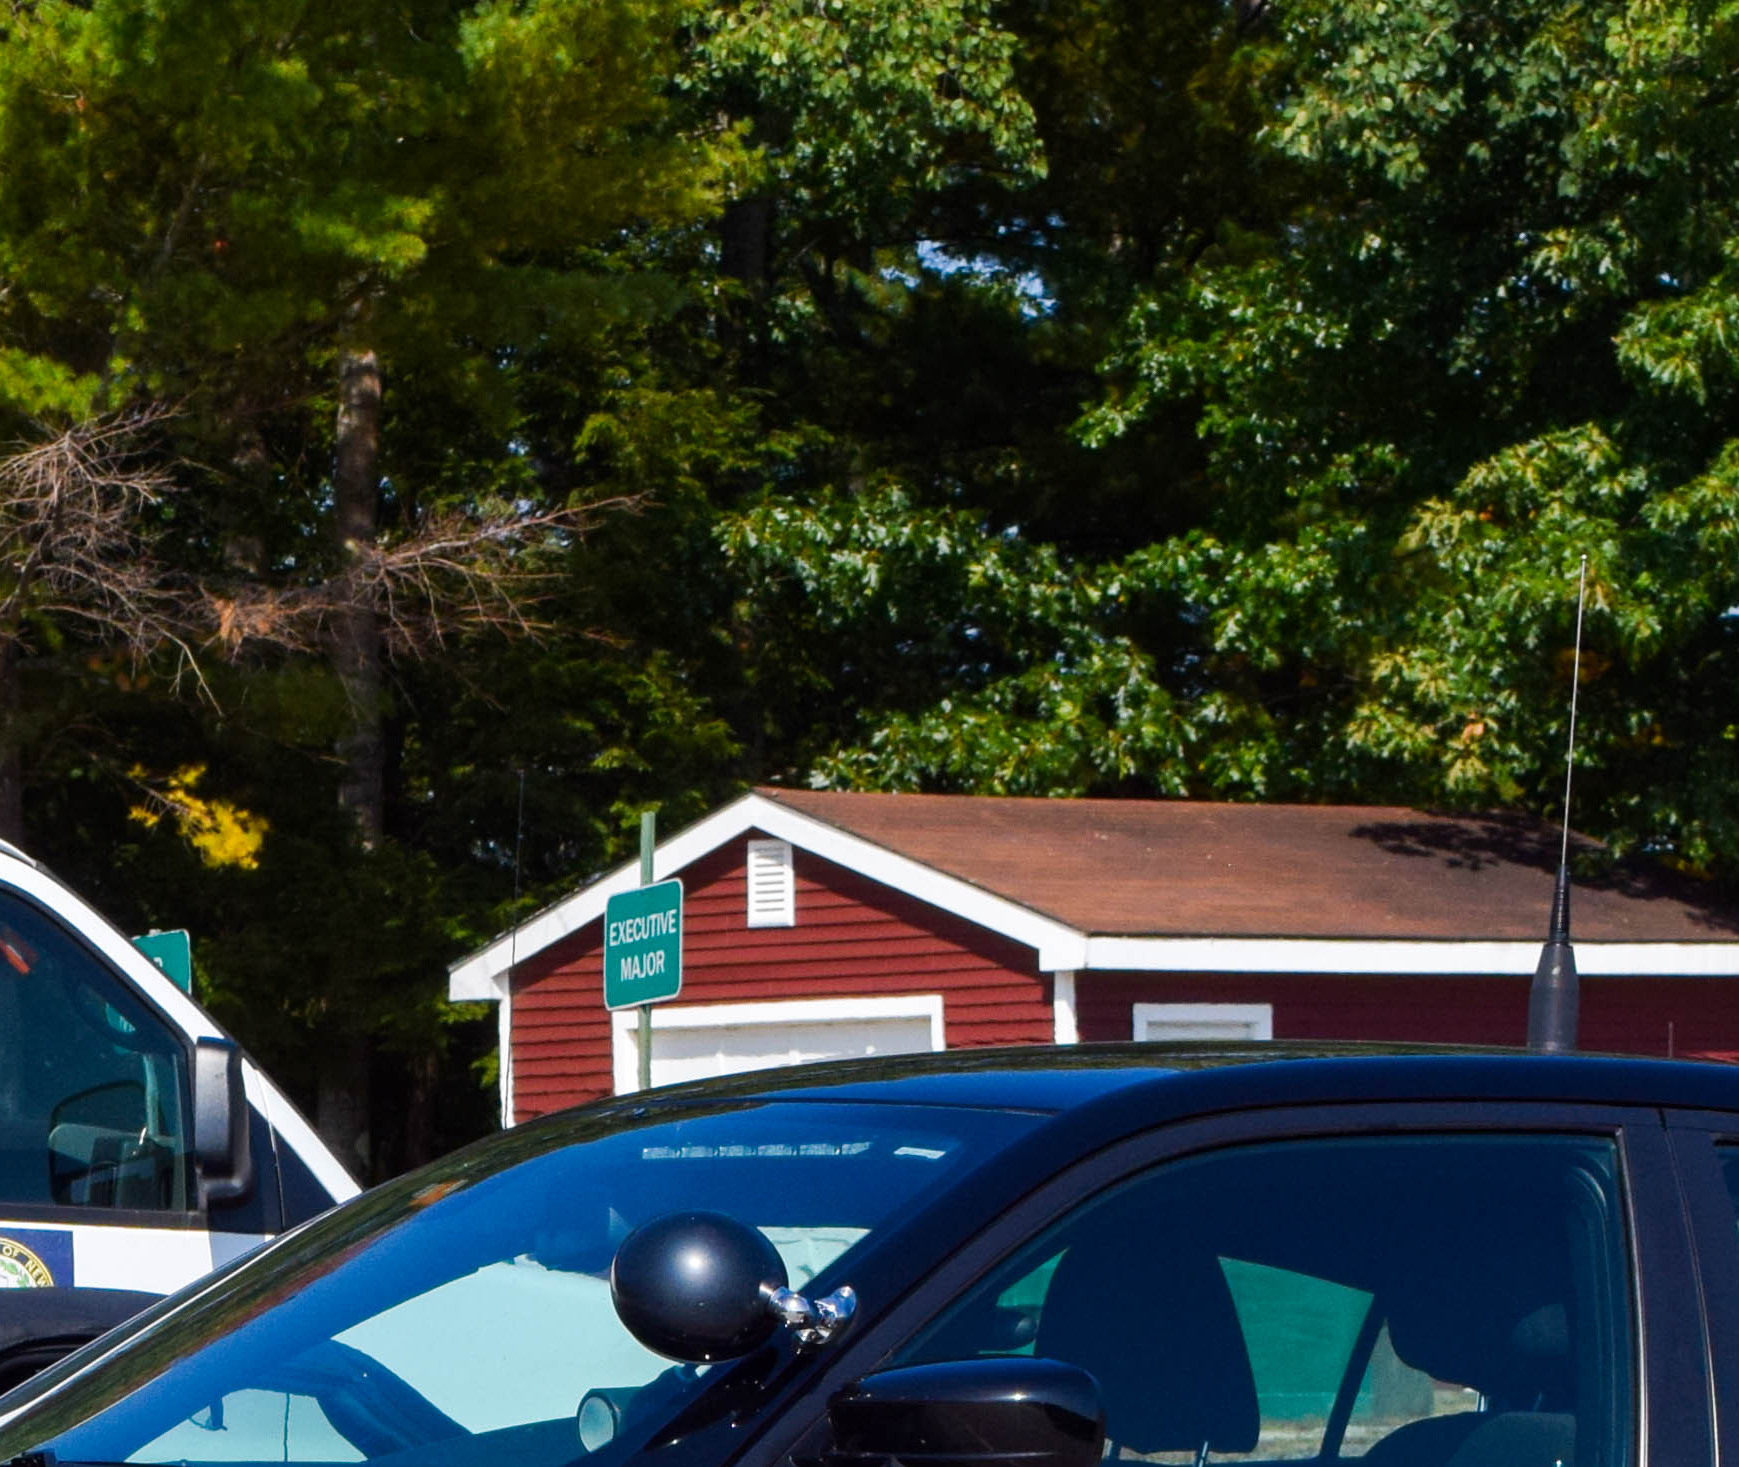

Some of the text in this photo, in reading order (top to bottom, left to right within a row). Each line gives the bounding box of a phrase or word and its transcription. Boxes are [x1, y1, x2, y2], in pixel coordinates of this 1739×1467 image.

[608, 908, 678, 947] EXECUTIVE
[620, 949, 666, 982] MAJOR
[2, 1247, 18, 1259] OF
